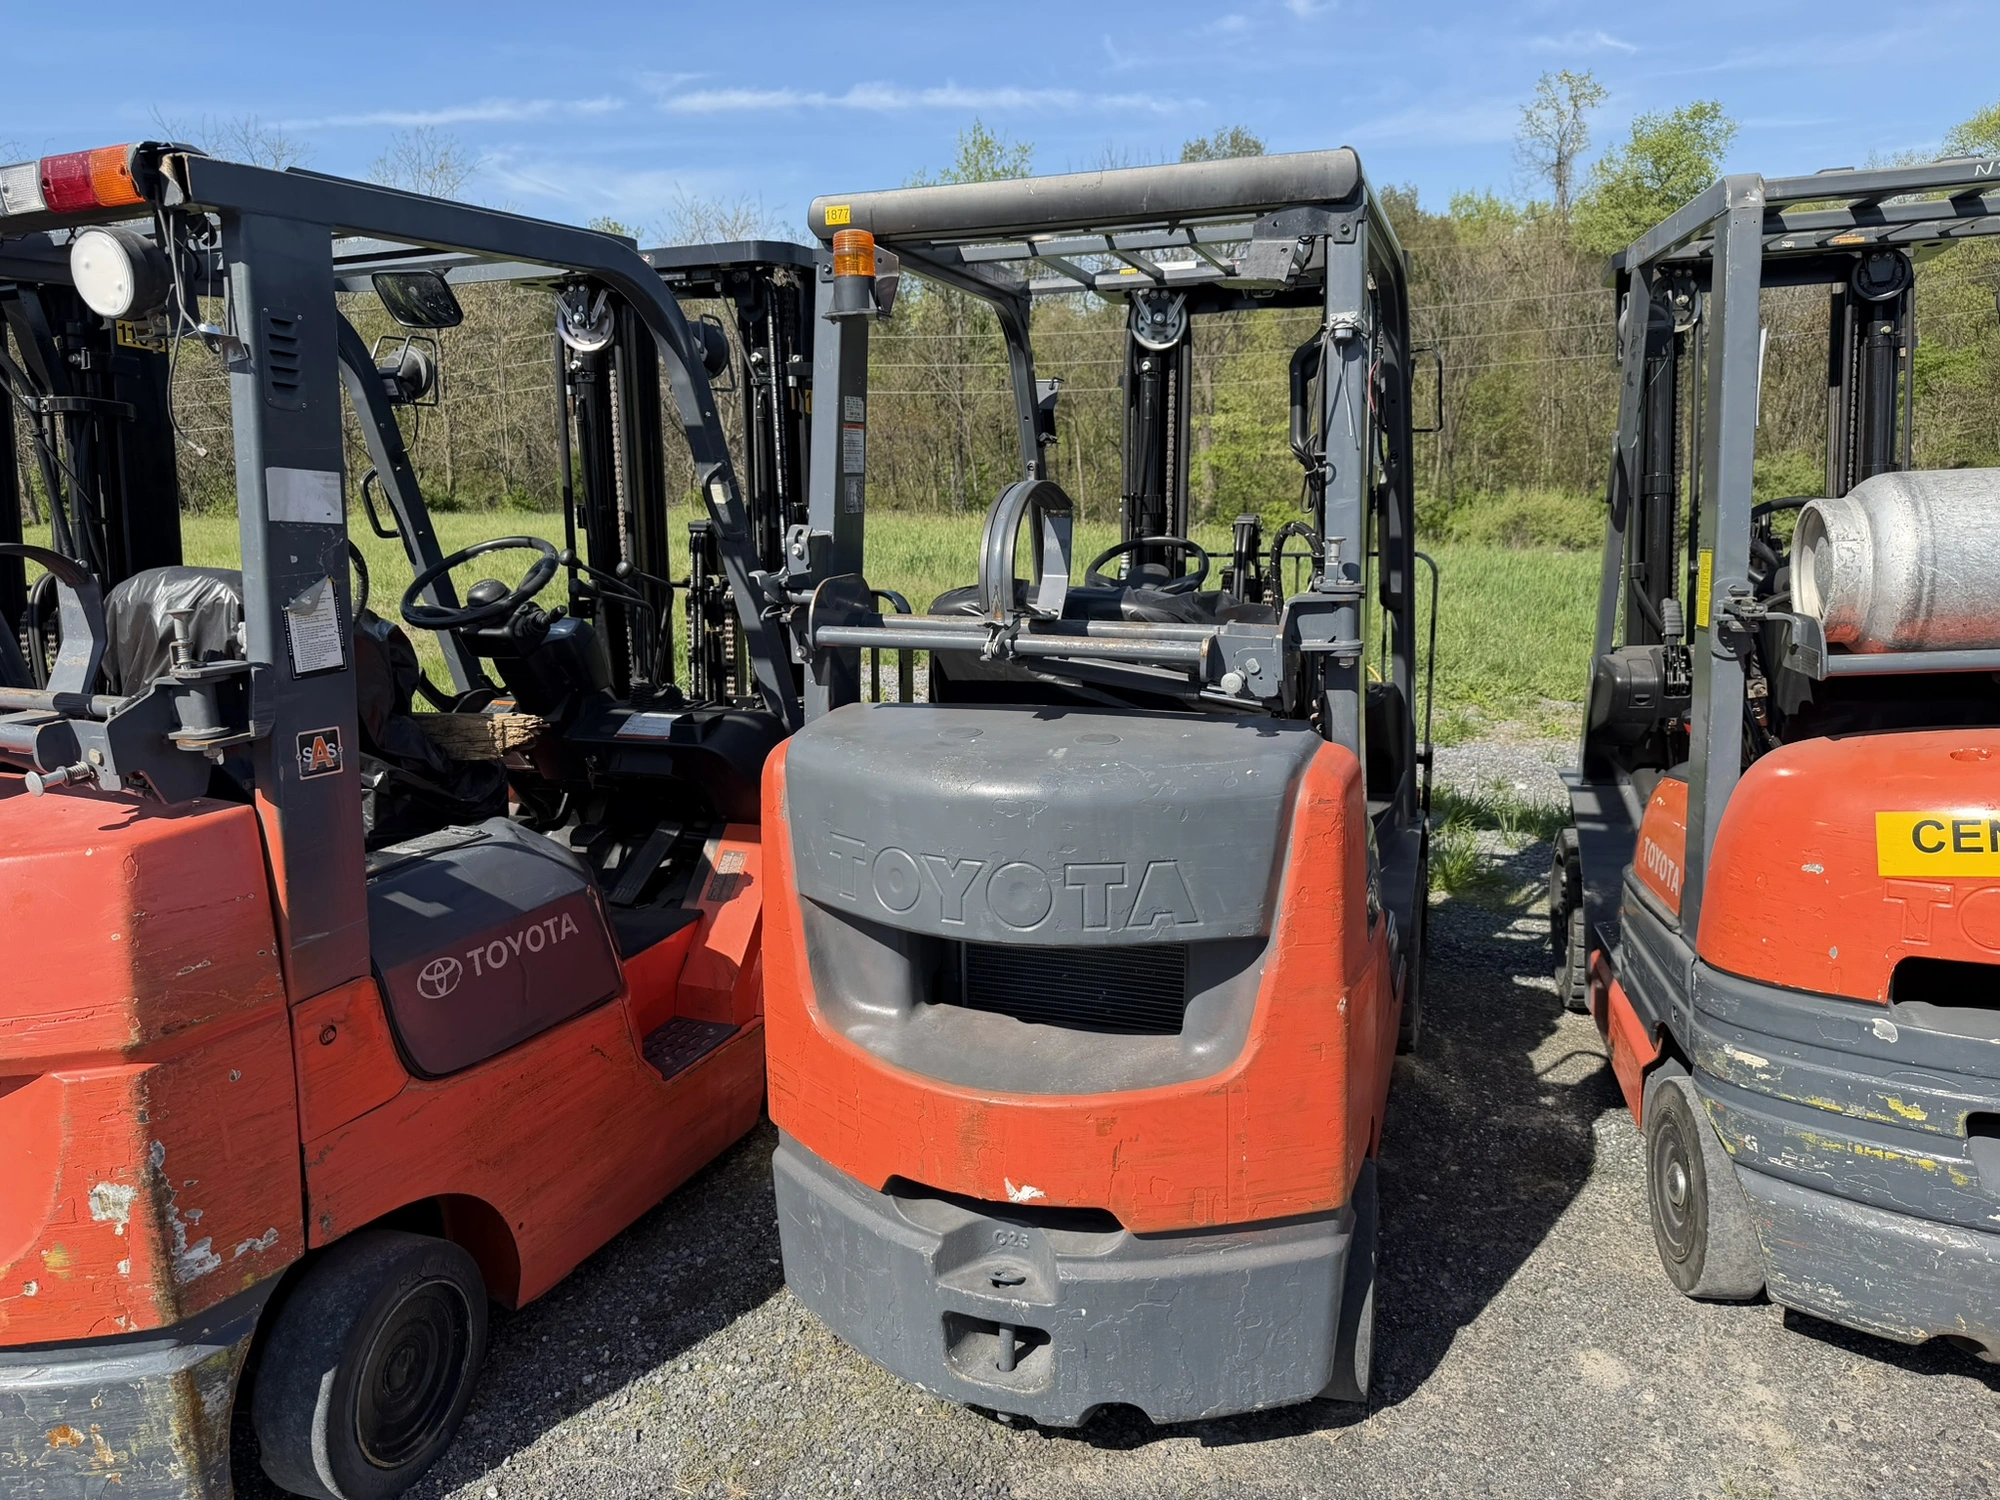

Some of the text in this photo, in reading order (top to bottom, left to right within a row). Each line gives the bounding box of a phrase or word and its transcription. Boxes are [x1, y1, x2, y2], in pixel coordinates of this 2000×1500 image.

[1975, 161, 2000, 176] N
[826, 208, 849, 222] 1877
[302, 736, 337, 771] SAS
[829, 831, 1203, 932] TOYOTA
[1643, 836, 1680, 897] TOYOTA
[466, 912, 579, 977] TOYOTA
